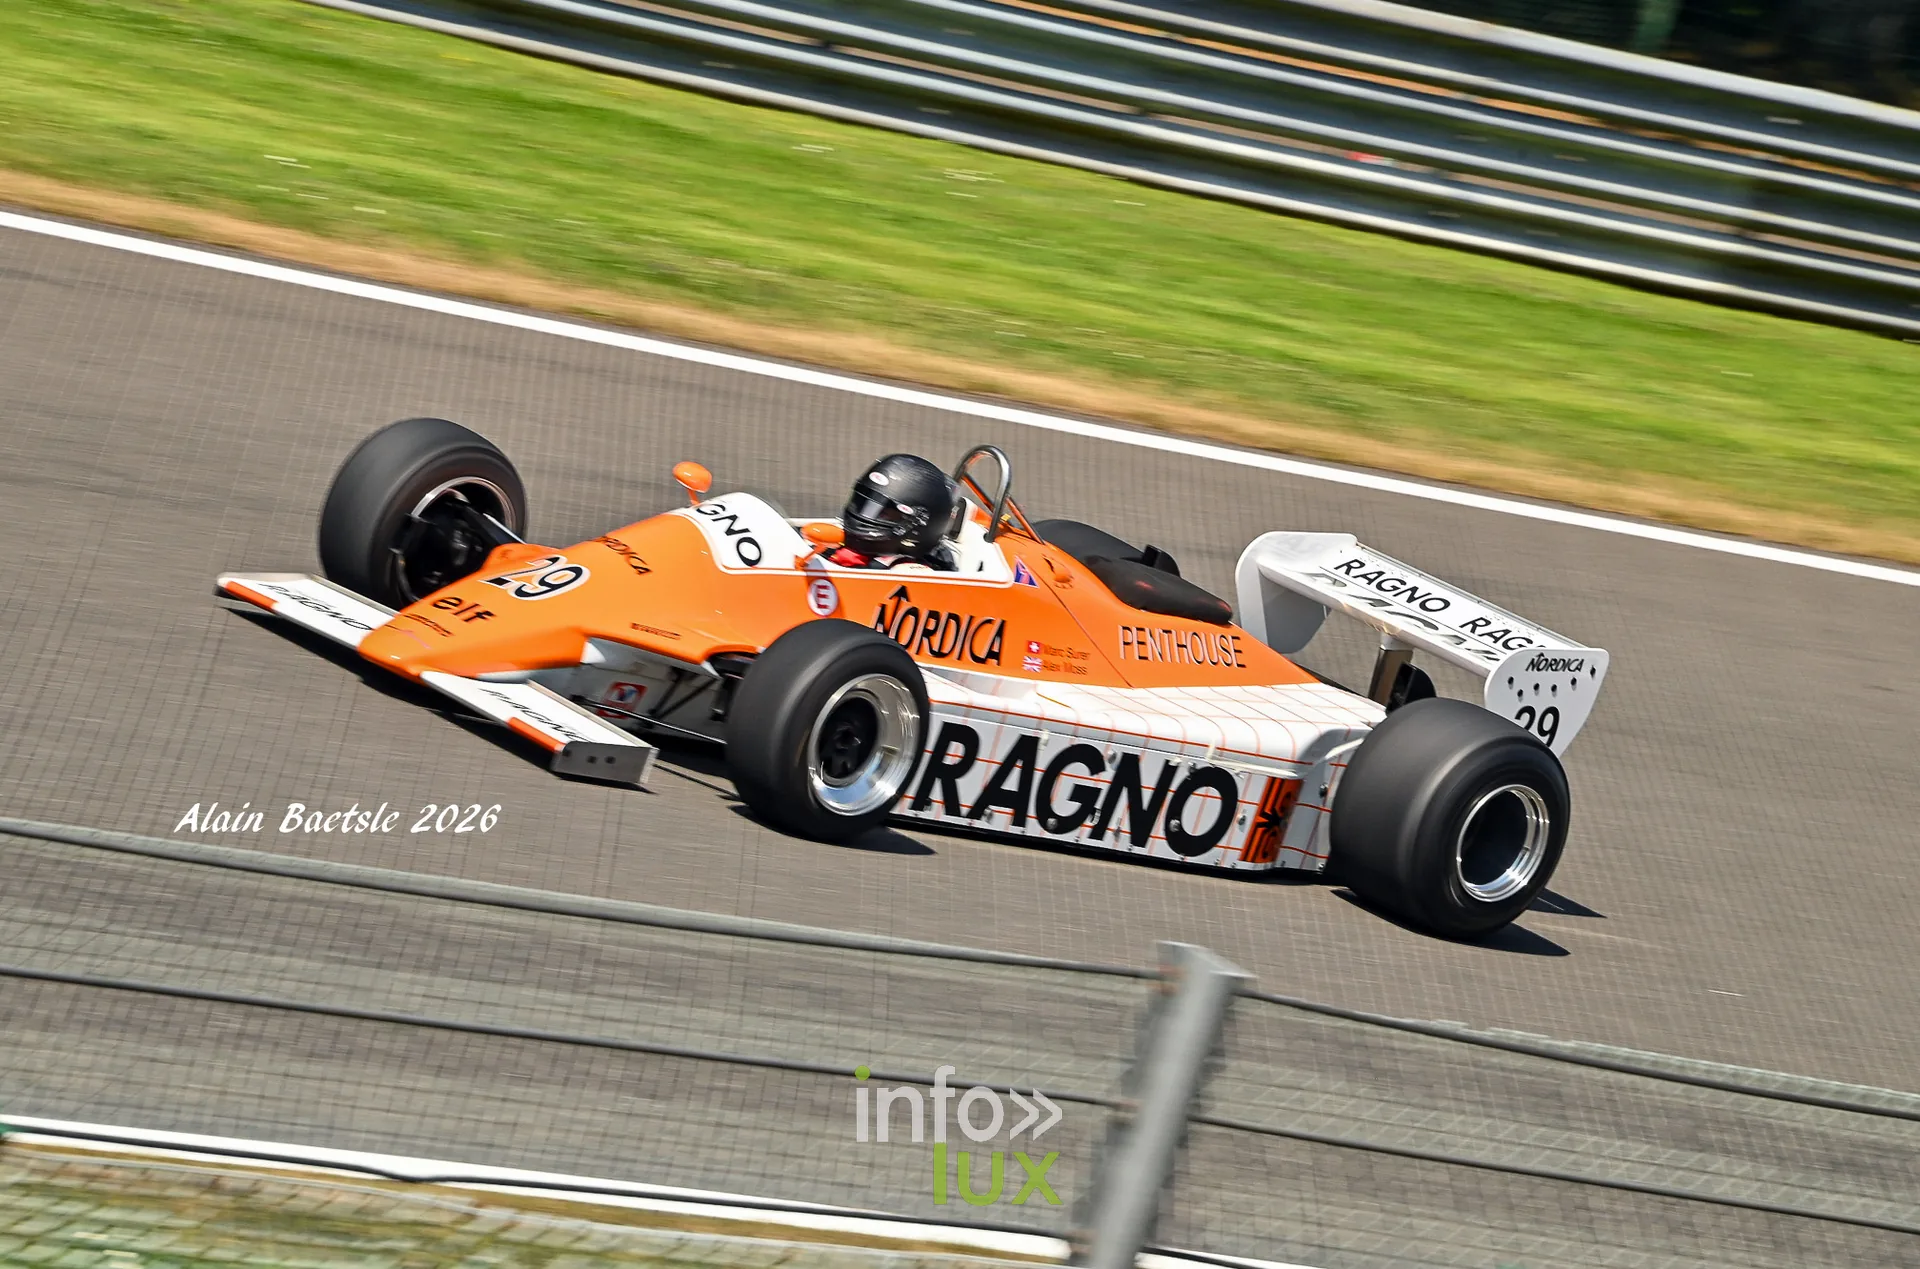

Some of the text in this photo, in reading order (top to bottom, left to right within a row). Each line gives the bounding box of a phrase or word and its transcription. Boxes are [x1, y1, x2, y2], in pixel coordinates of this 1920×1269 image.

[482, 555, 588, 599] 29
[814, 584, 831, 610] E
[430, 596, 497, 623] elf
[871, 585, 1006, 666] NORDICA
[1334, 558, 1451, 613] RAGNO
[1459, 616, 1545, 651] RAG
[1118, 625, 1246, 668] PENTHOUSE
[1525, 652, 1585, 672] NORDICA
[909, 721, 1238, 857] RAGNO
